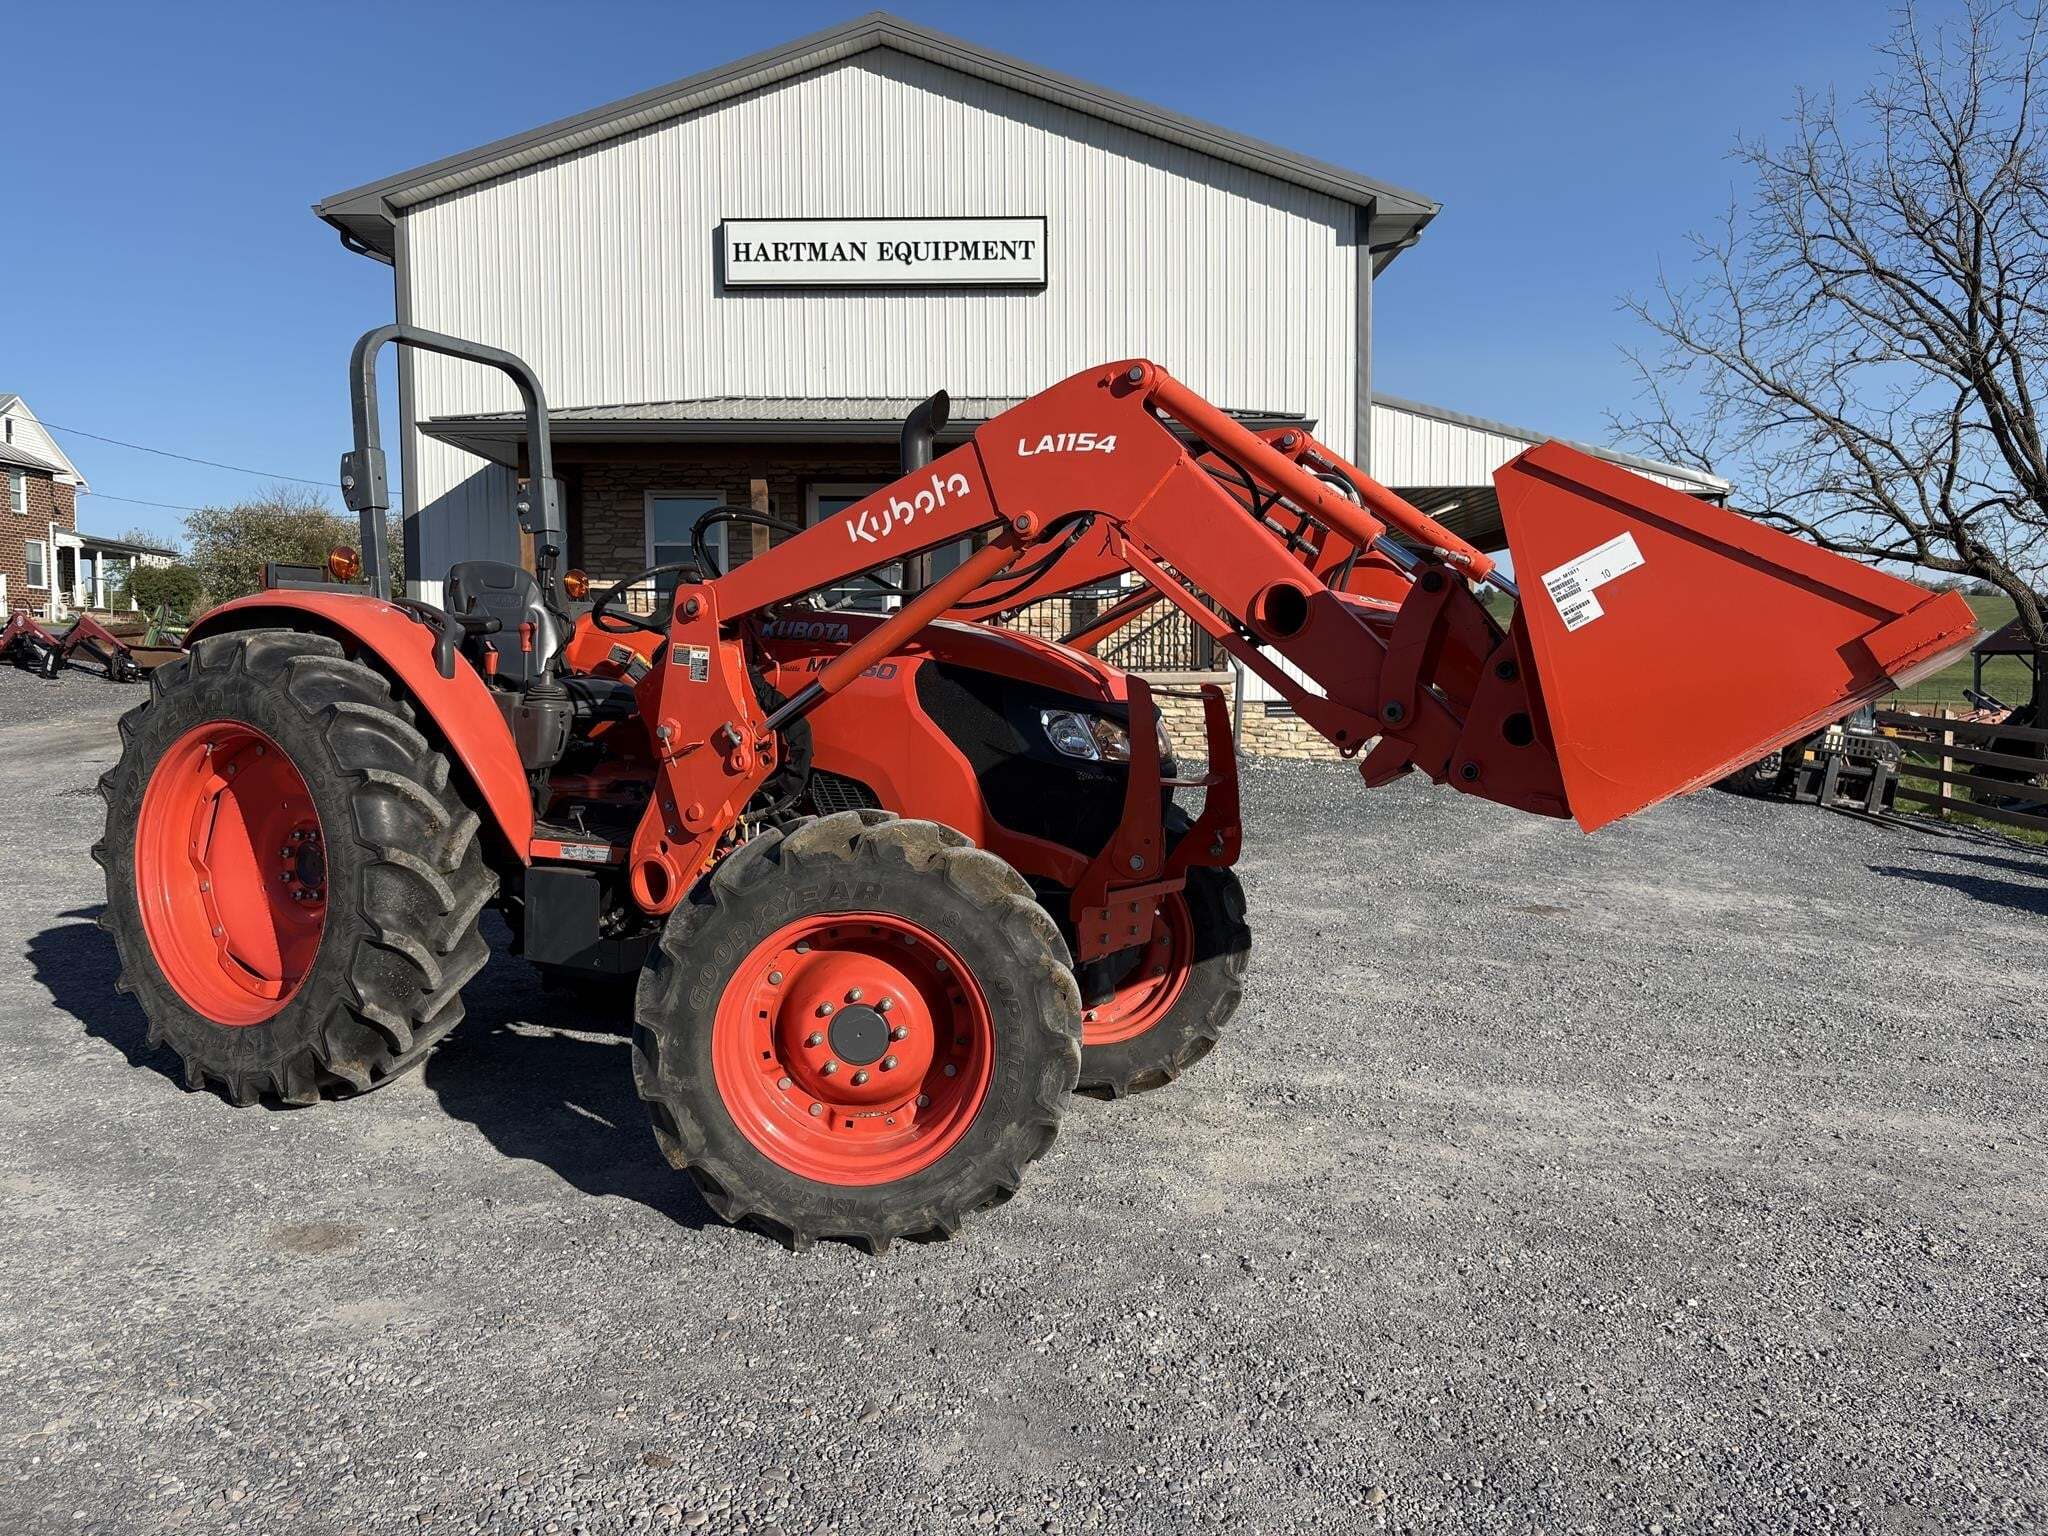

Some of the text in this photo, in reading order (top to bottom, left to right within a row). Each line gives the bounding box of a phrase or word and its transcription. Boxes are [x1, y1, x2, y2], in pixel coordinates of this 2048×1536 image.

[733, 240, 1036, 265] HARTMAN EQUIPMENT
[1017, 433, 1117, 457] LA1154
[846, 473, 970, 543] Kubota
[762, 620, 849, 641] KUBOTA
[688, 879, 884, 1010] GOODYEAR
